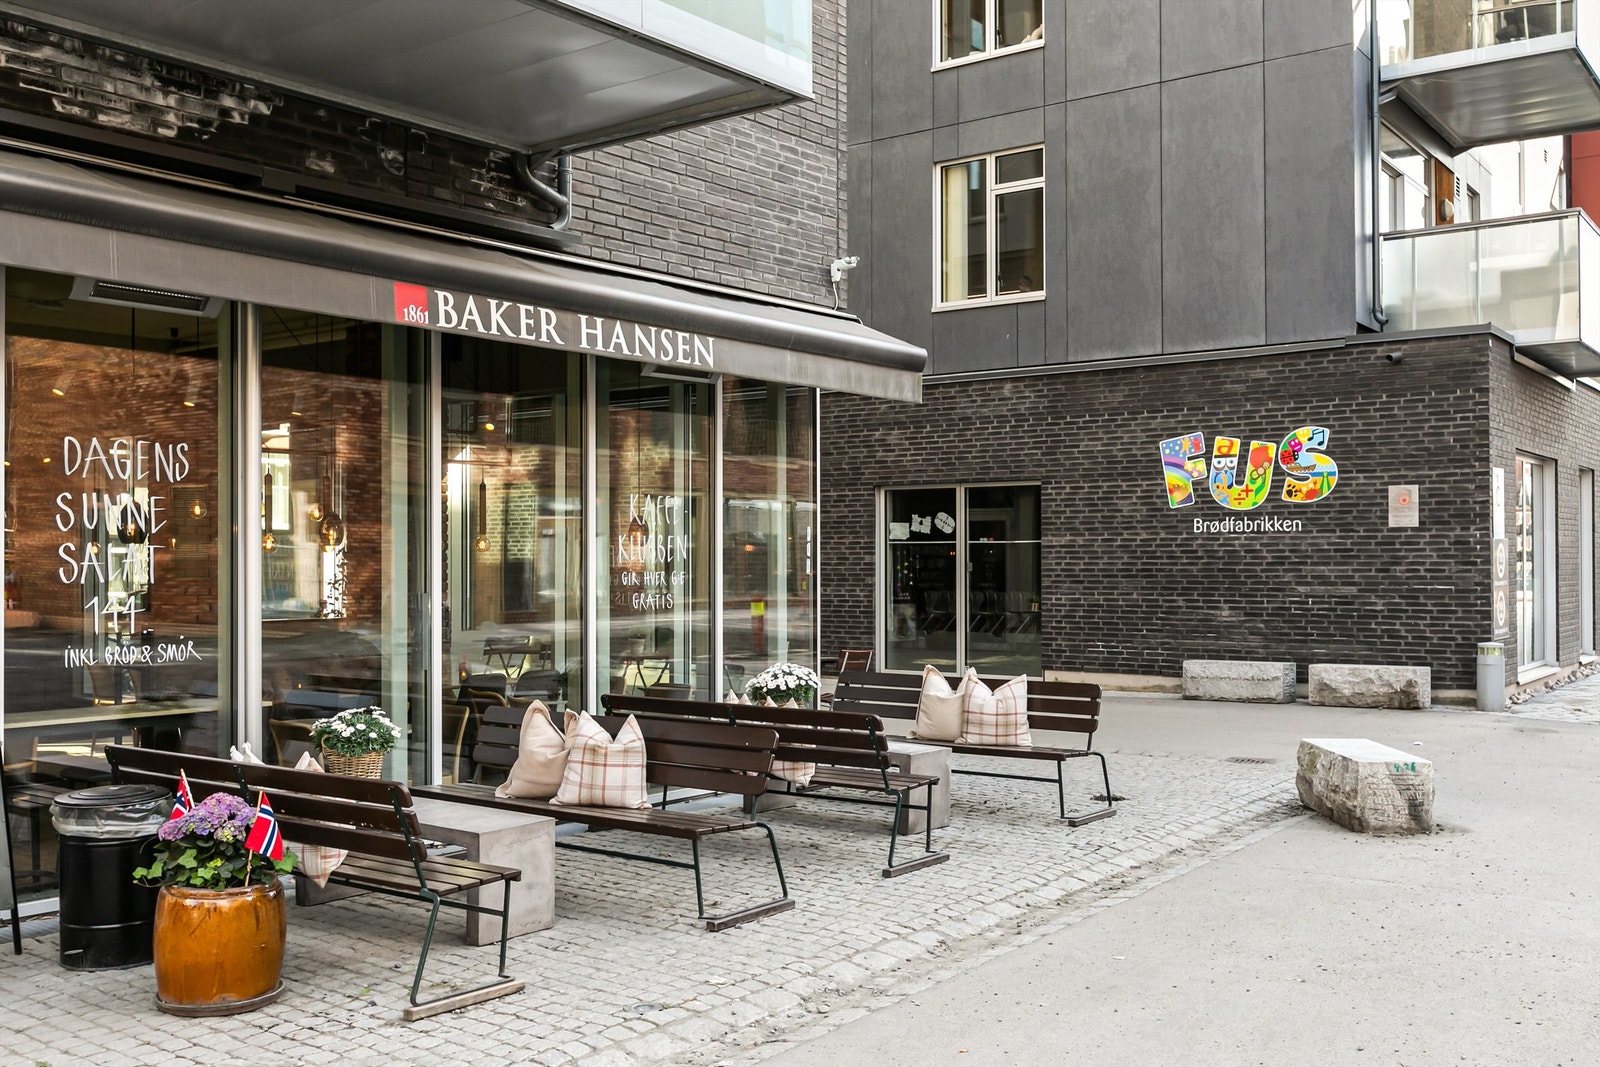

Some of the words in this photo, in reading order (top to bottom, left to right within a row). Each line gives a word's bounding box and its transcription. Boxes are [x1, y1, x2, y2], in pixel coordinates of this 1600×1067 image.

[403, 304, 429, 325] 1861
[434, 289, 565, 345] BAKER
[577, 313, 715, 369] HANSEN
[63, 435, 189, 483] DAGENS
[1159, 426, 1339, 510] FUS
[55, 491, 168, 535] SUNNE
[1193, 515, 1303, 533] Brødfabrikken
[58, 542, 167, 585] SALAT
[643, 570, 667, 587] HVER
[632, 591, 674, 611] GRATIS
[140, 645, 154, 666] &
